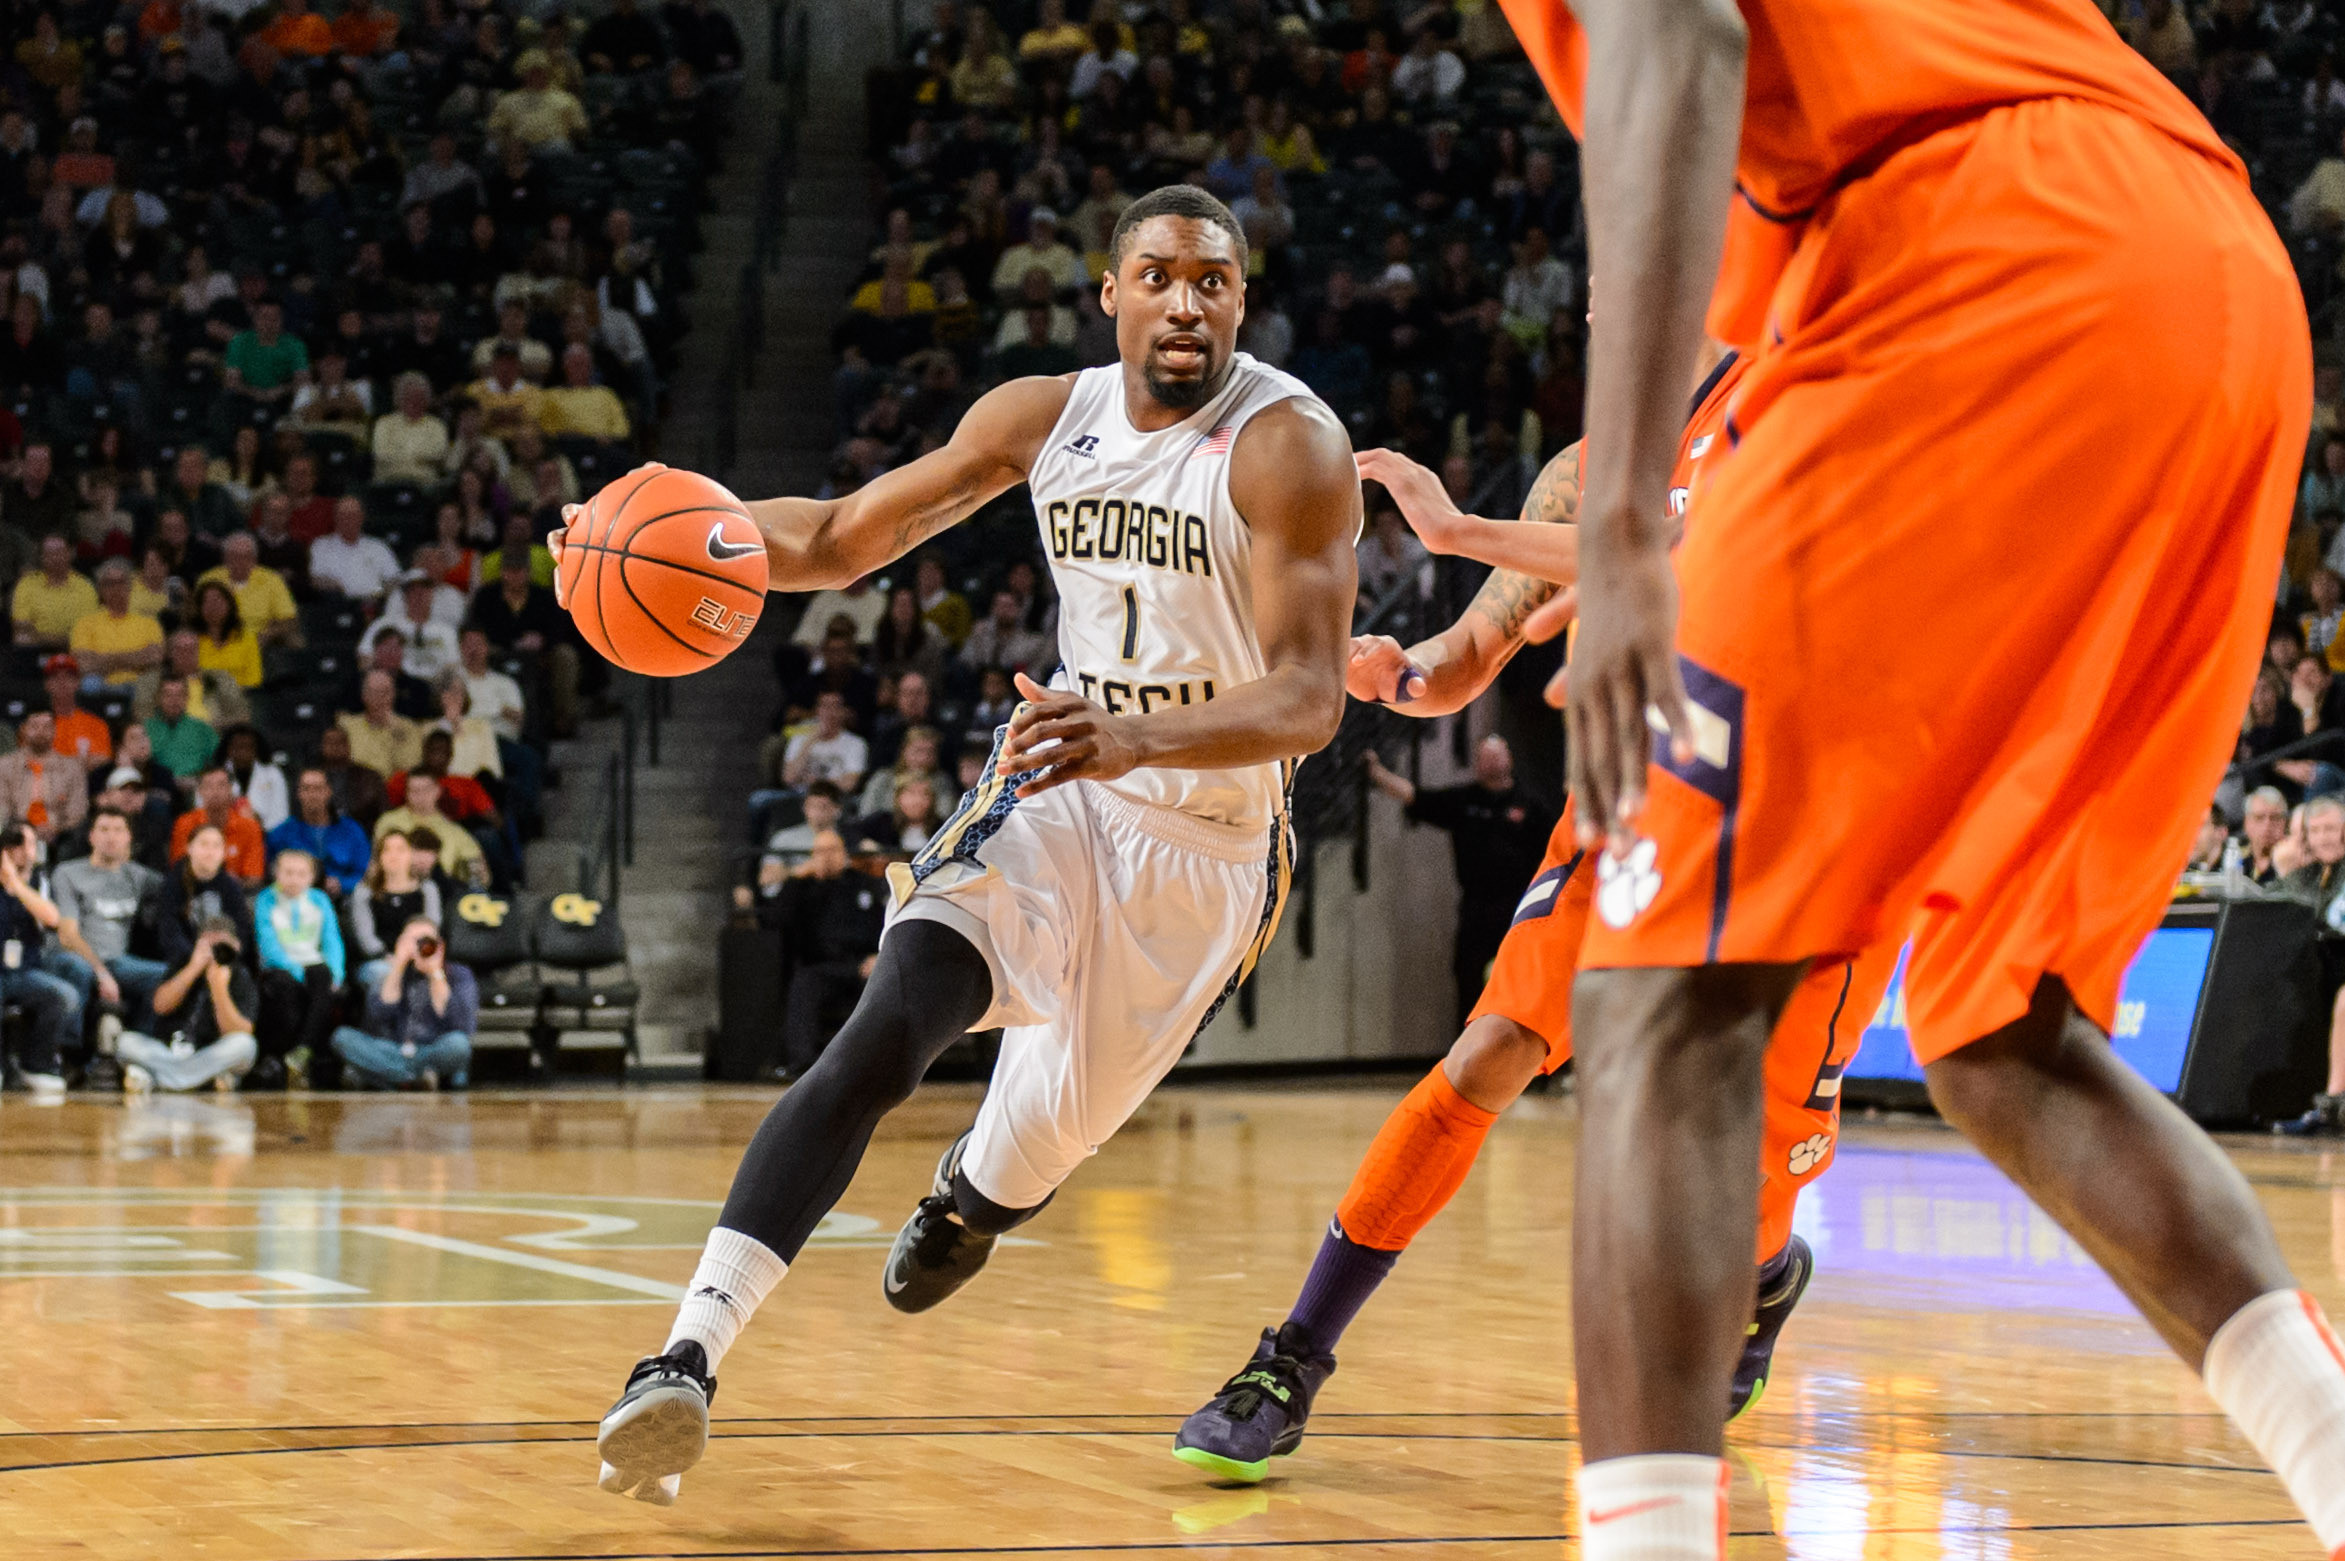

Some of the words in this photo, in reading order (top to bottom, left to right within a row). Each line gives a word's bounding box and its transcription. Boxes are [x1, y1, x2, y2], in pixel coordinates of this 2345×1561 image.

[1049, 499, 1212, 578] GEORGIA
[691, 596, 756, 637] ELITE
[1120, 581, 1141, 664] 1
